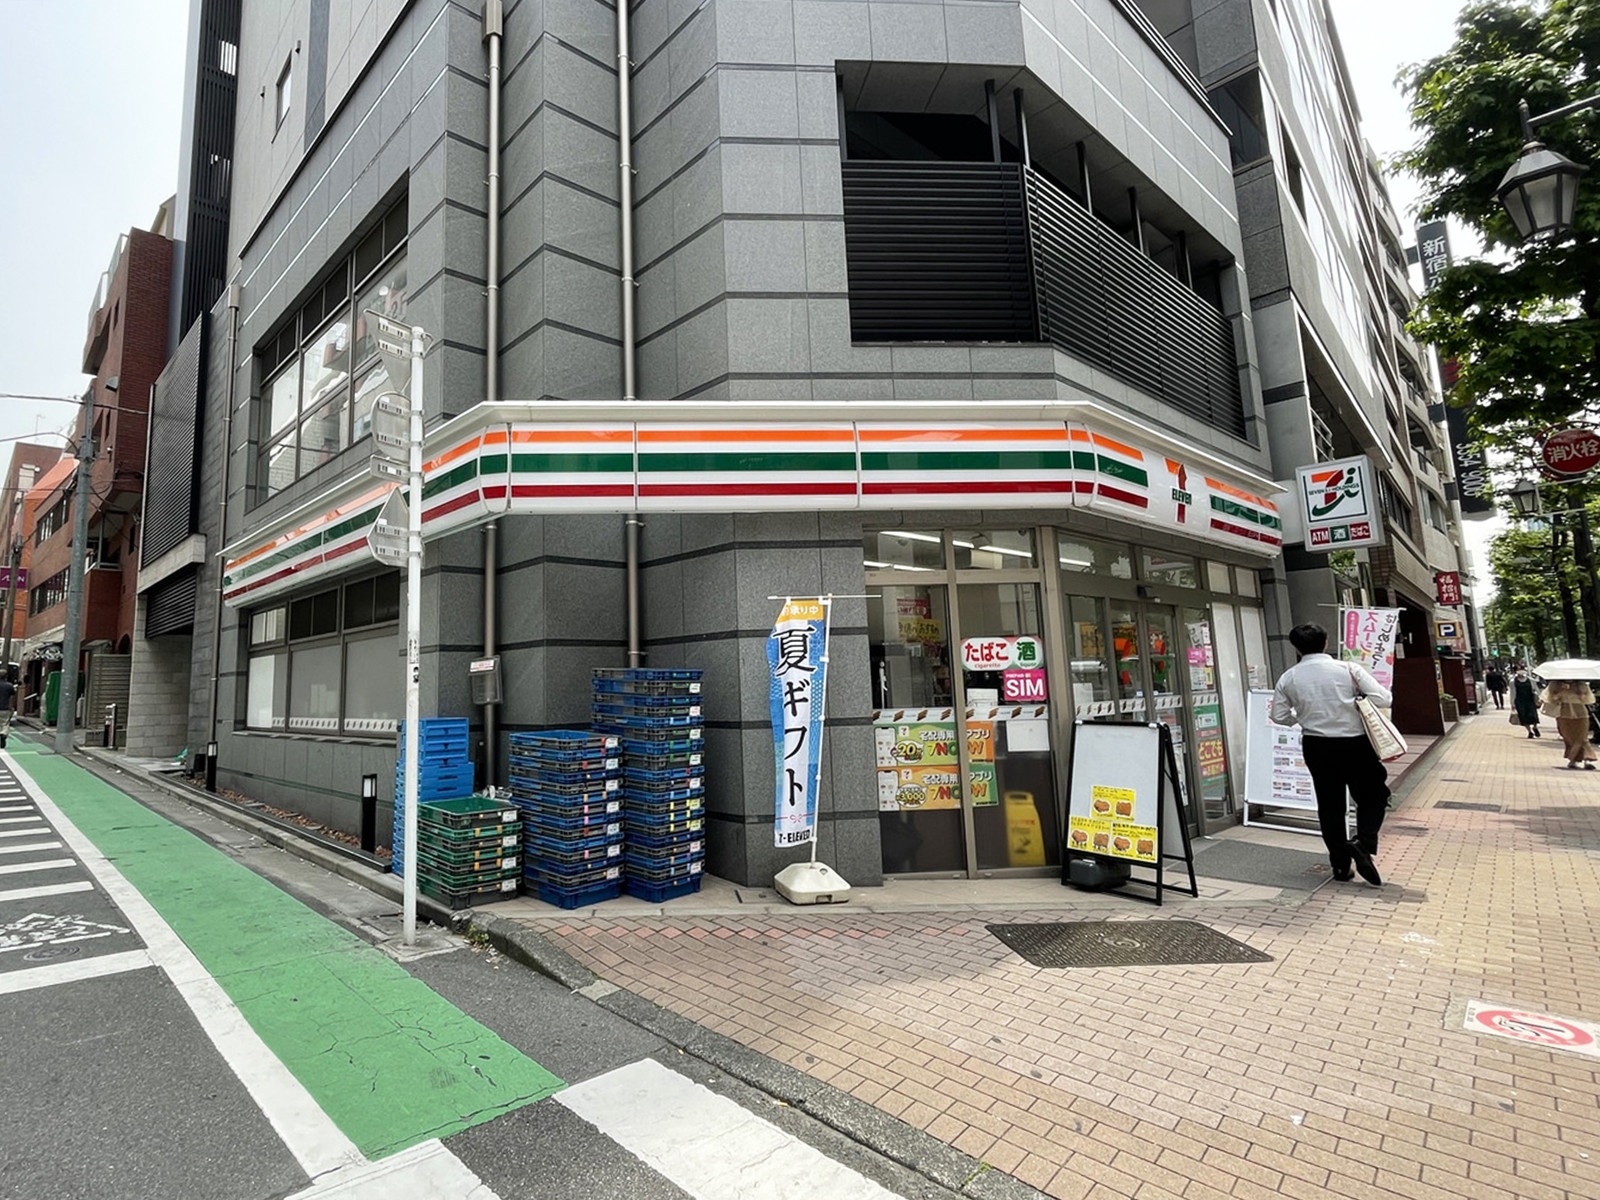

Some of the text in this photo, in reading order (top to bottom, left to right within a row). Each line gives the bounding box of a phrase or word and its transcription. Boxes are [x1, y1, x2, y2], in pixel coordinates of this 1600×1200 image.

[1547, 439, 1600, 464] 消火栓
[1312, 530, 1329, 542] ATM
[1333, 528, 1346, 539] 酒
[1439, 624, 1455, 636] P
[965, 641, 1036, 662] たばこ 酒
[1006, 679, 1044, 697] SIM
[772, 626, 817, 807] 夏ギフト
